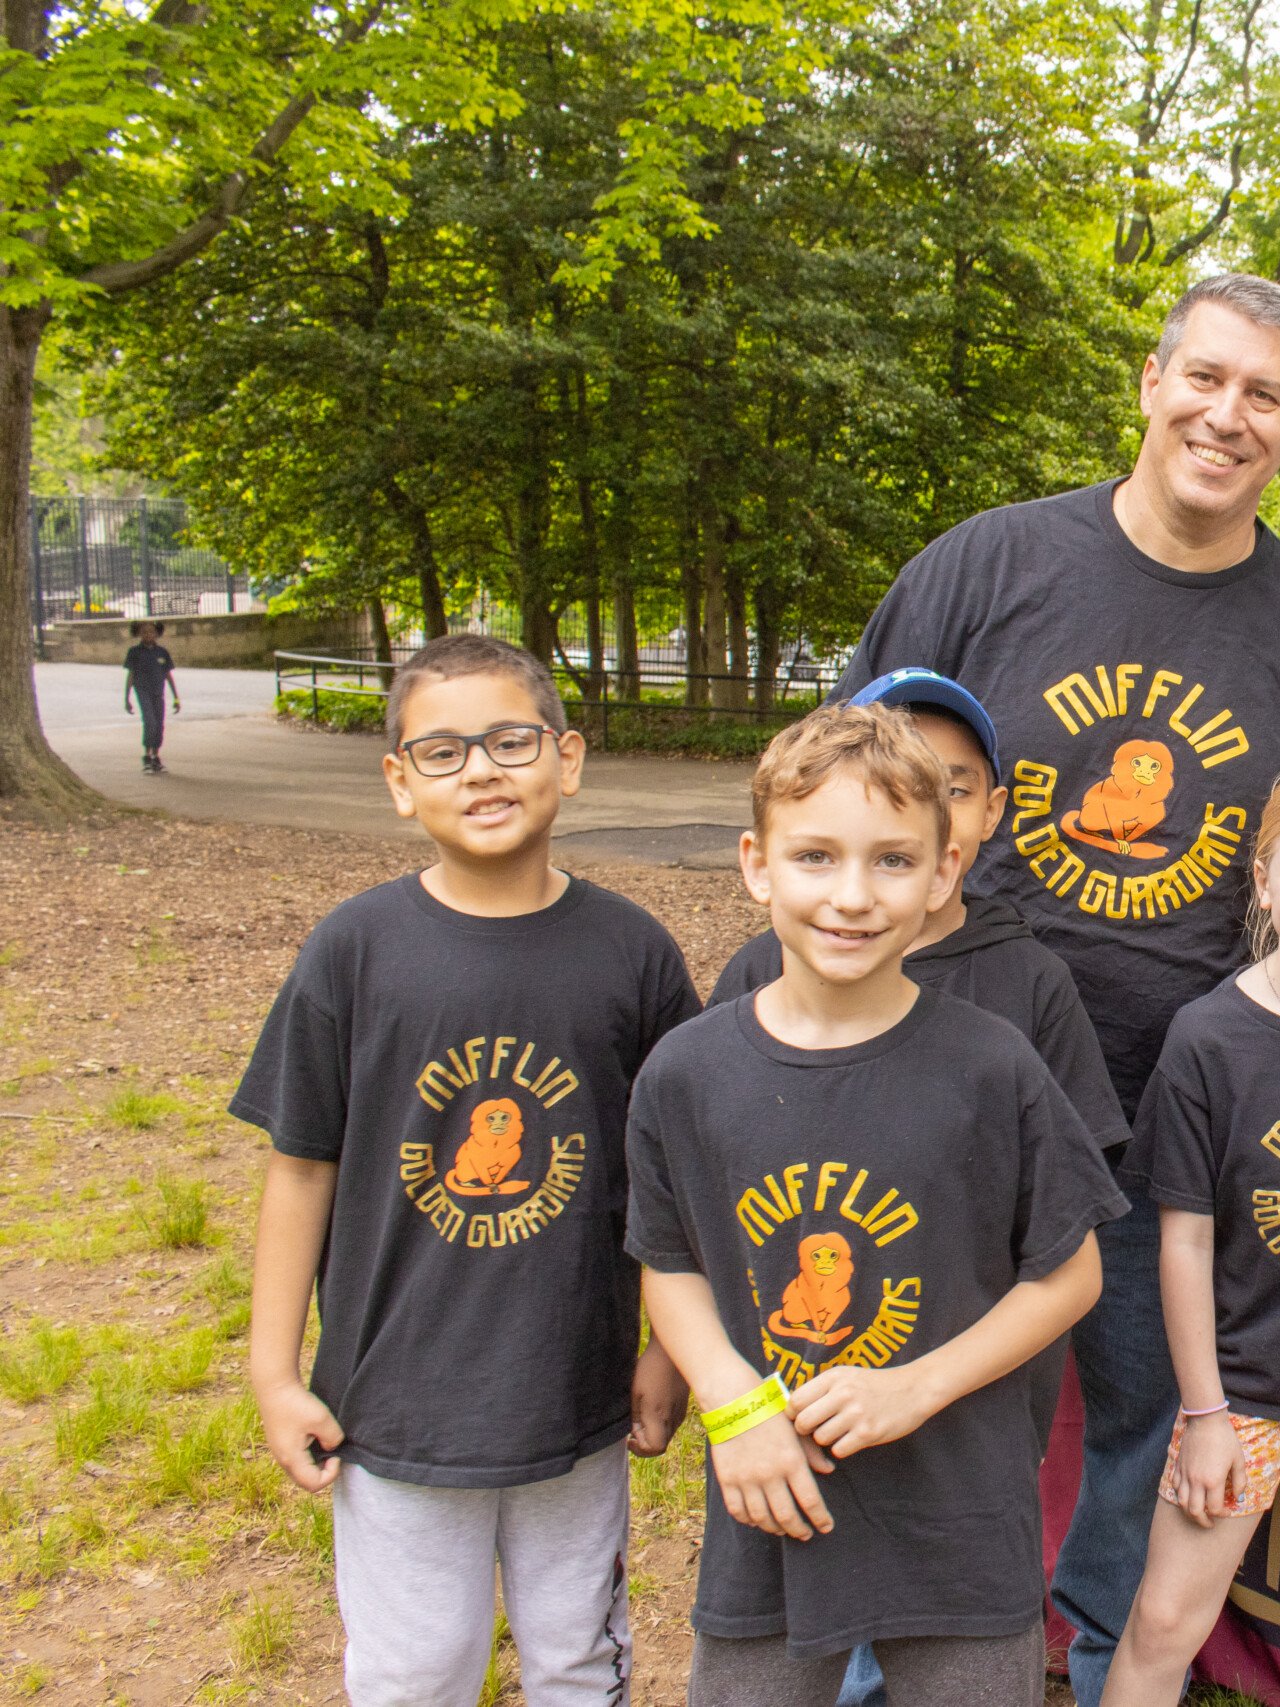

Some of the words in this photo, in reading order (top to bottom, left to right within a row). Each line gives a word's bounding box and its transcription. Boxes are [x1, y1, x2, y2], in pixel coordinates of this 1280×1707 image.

[1043, 664, 1249, 769] MIFFLIN
[1012, 760, 1086, 898] GOLDEN
[1078, 803, 1246, 919] GUARDIANS
[415, 1036, 580, 1112] MIFFLIN
[400, 1142, 466, 1243] GOLDEN
[466, 1133, 586, 1248] GUARDIANS
[736, 1161, 919, 1248] MIFFLIN
